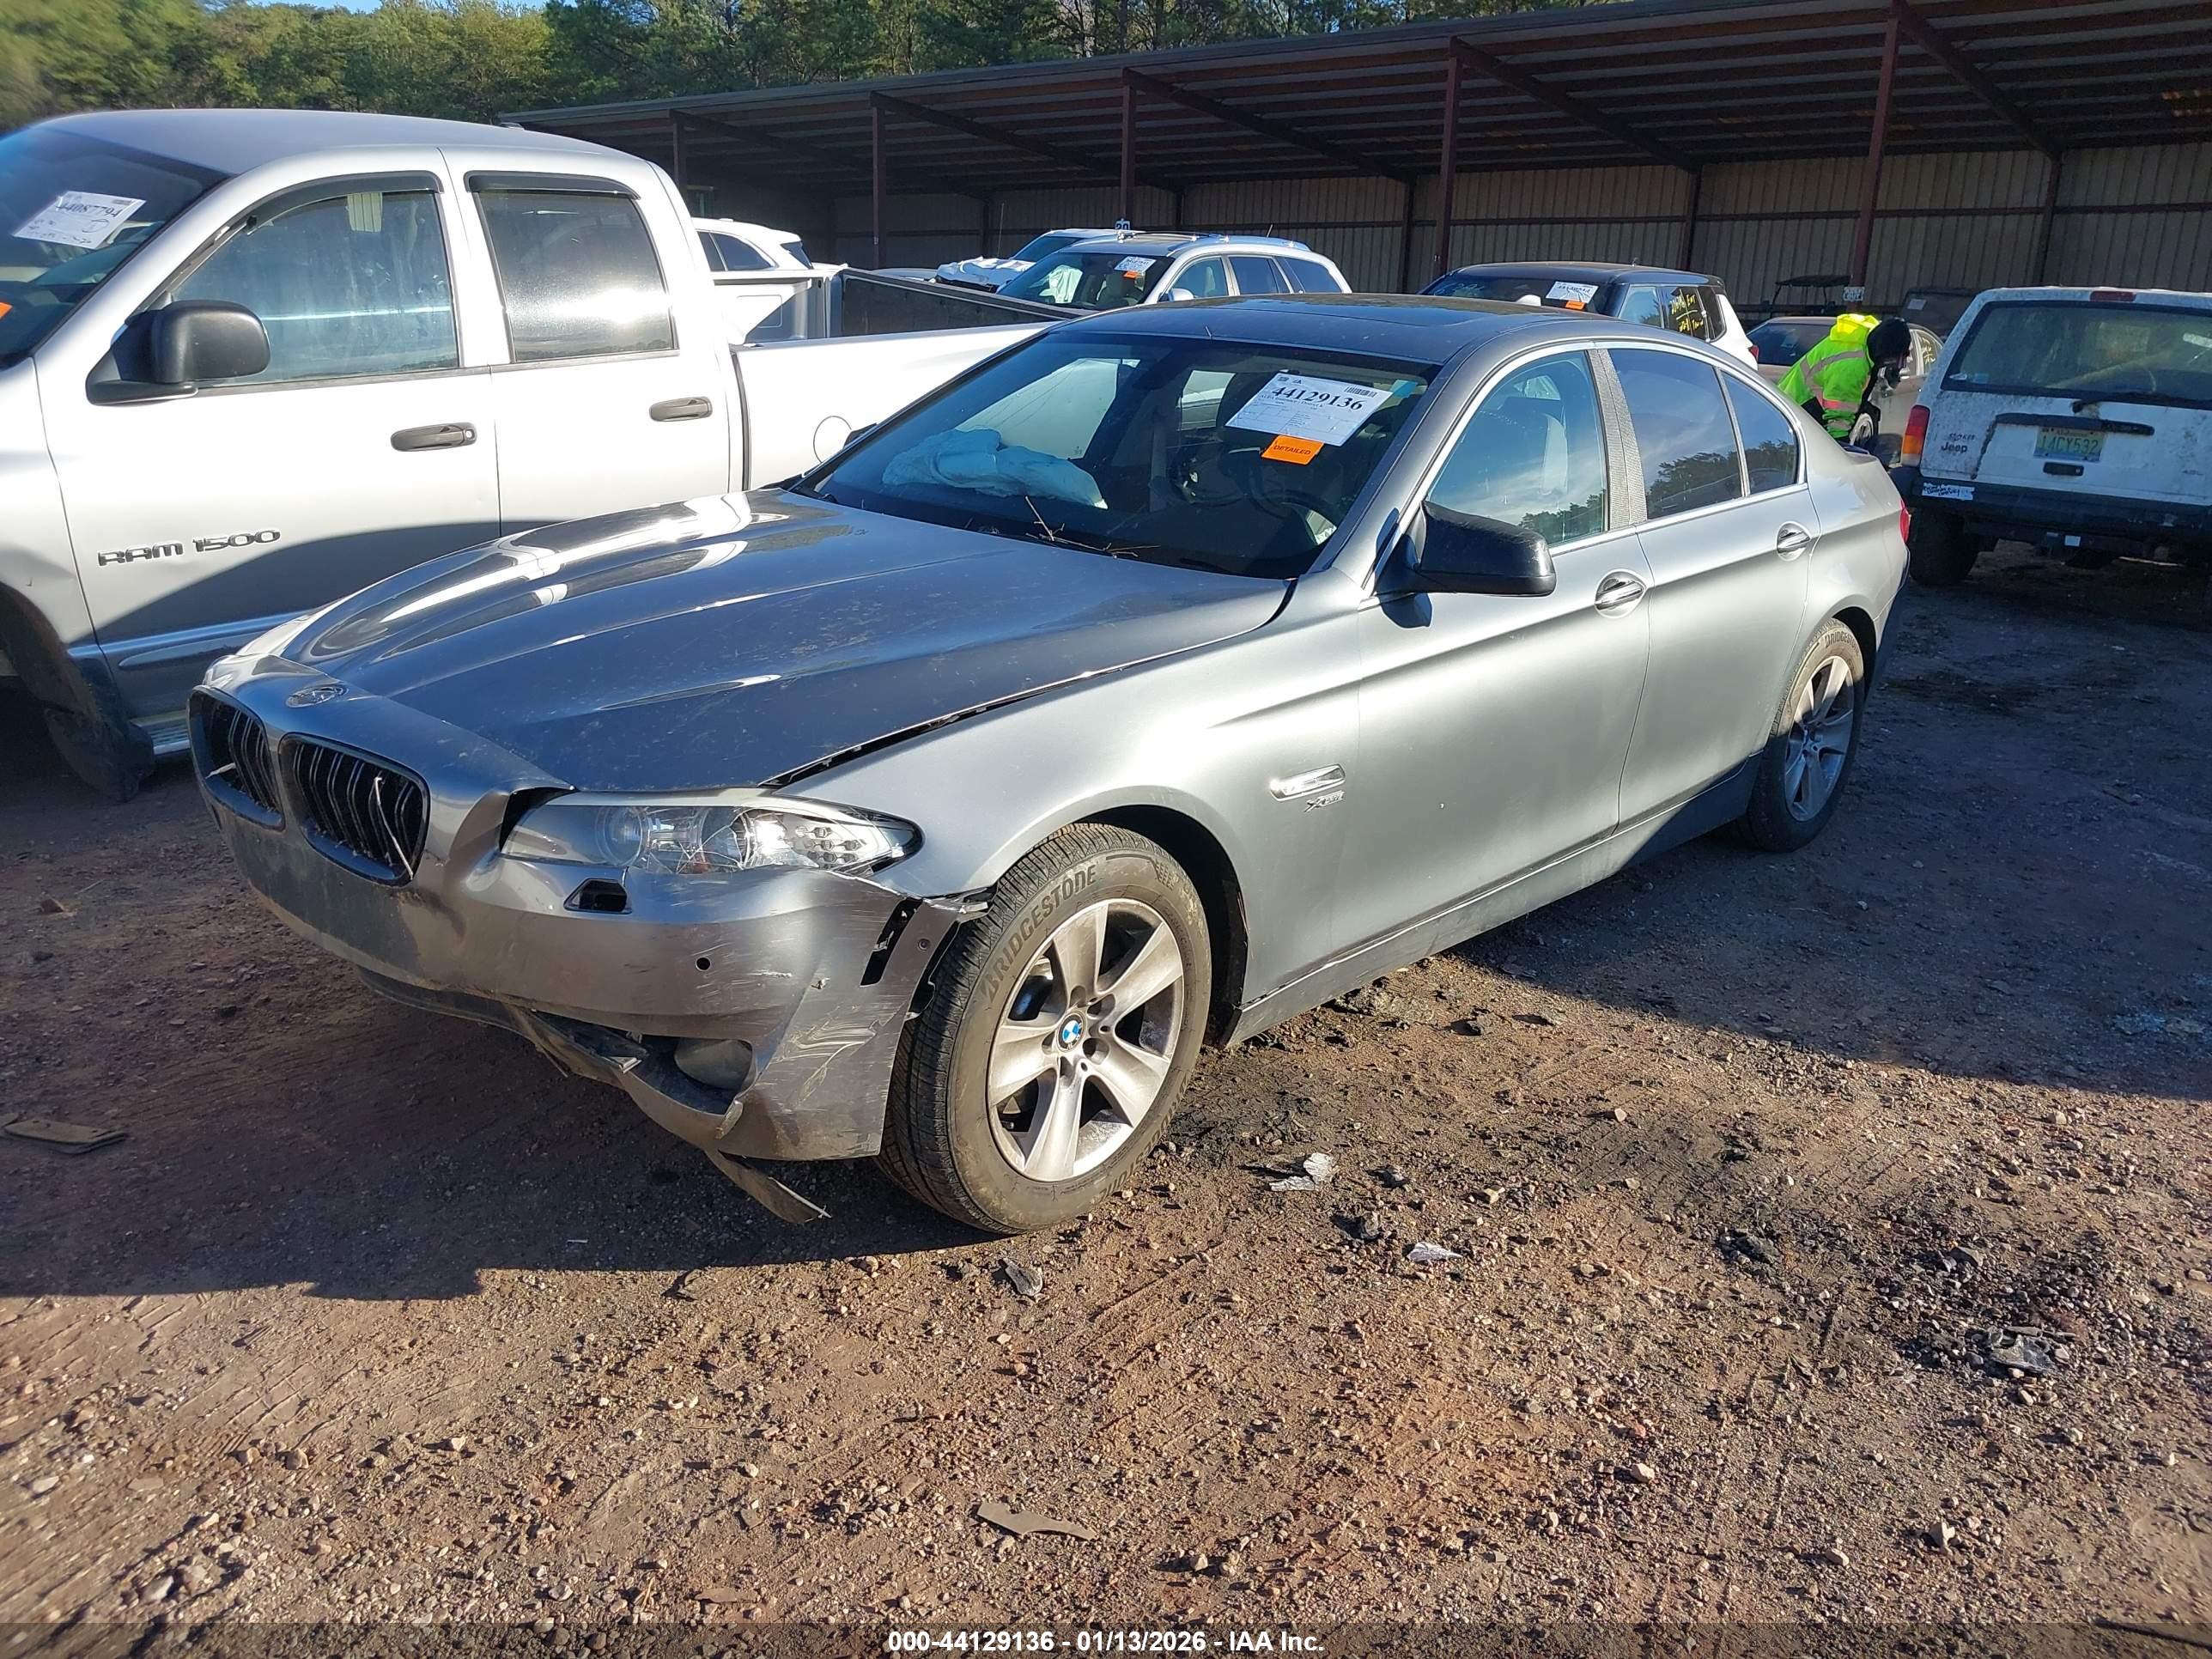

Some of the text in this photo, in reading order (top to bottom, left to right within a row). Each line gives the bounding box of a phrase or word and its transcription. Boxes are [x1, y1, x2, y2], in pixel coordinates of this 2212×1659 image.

[1272, 386, 1366, 410] 44129136
[1273, 445, 1311, 455] DETAILED
[1941, 441, 1968, 453] Jeep
[98, 530, 281, 566] RAM 1500
[983, 864, 1097, 1002] BRIDGESTONE
